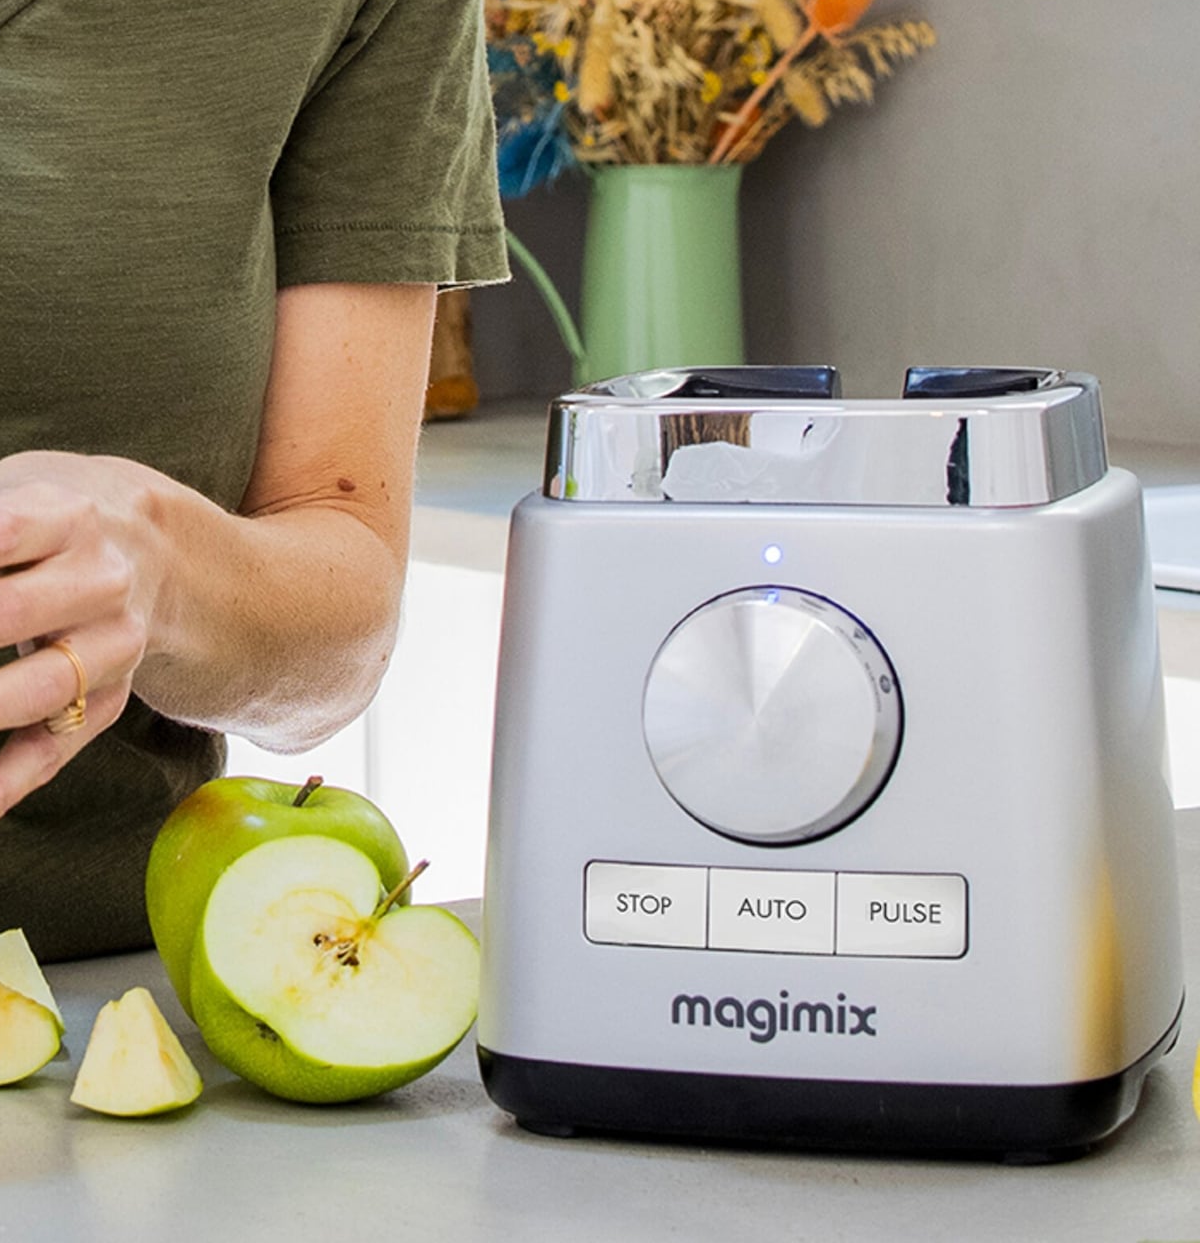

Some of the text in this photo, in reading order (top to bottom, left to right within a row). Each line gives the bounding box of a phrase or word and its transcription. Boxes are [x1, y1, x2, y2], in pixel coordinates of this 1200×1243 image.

[616, 893, 672, 915] STOP
[737, 897, 807, 921] AUTO
[870, 901, 942, 924] PULSE
[671, 989, 877, 1044] magimix
